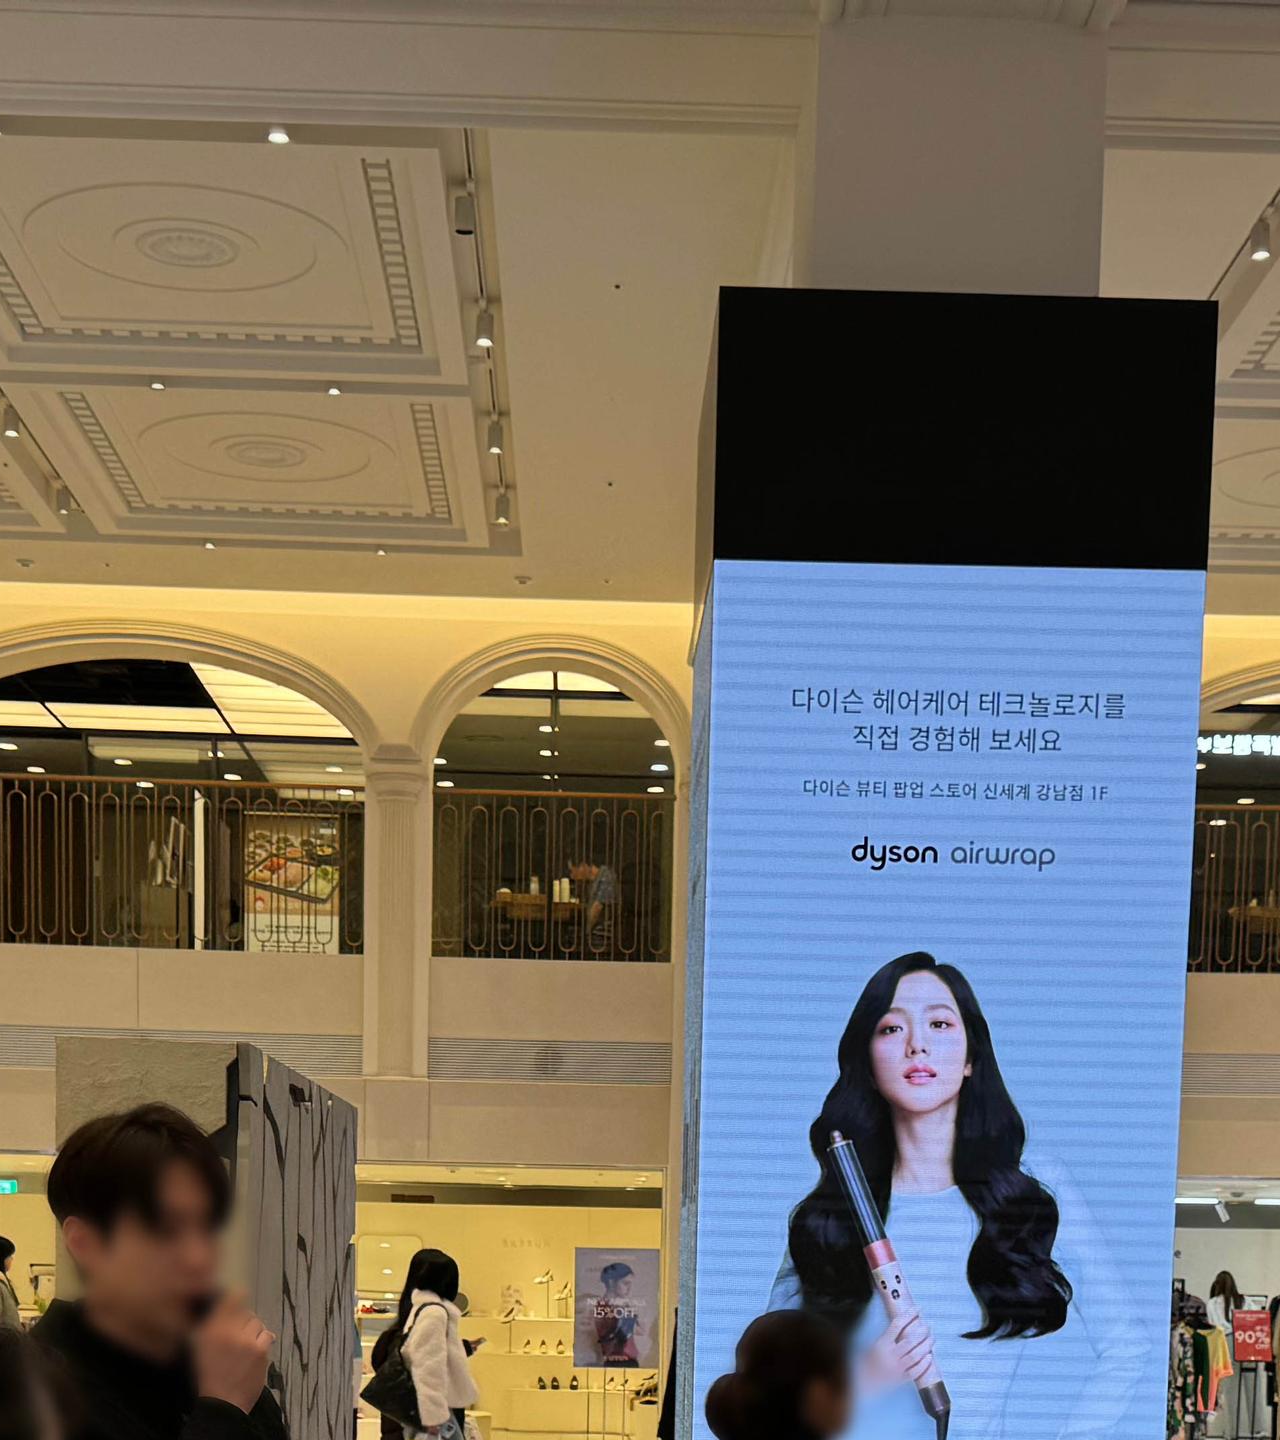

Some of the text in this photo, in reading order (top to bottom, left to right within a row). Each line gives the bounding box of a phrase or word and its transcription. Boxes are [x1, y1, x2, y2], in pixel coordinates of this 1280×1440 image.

[791, 687, 1126, 720] 다이슨 헤어케어 테크놀로지를
[853, 724, 1062, 754] 직접 경험해 보세요
[803, 778, 1109, 801] 다이슨 뷰티 팝업 스토어 신세계 강남점 1F
[851, 835, 1056, 872] dyson airwrap
